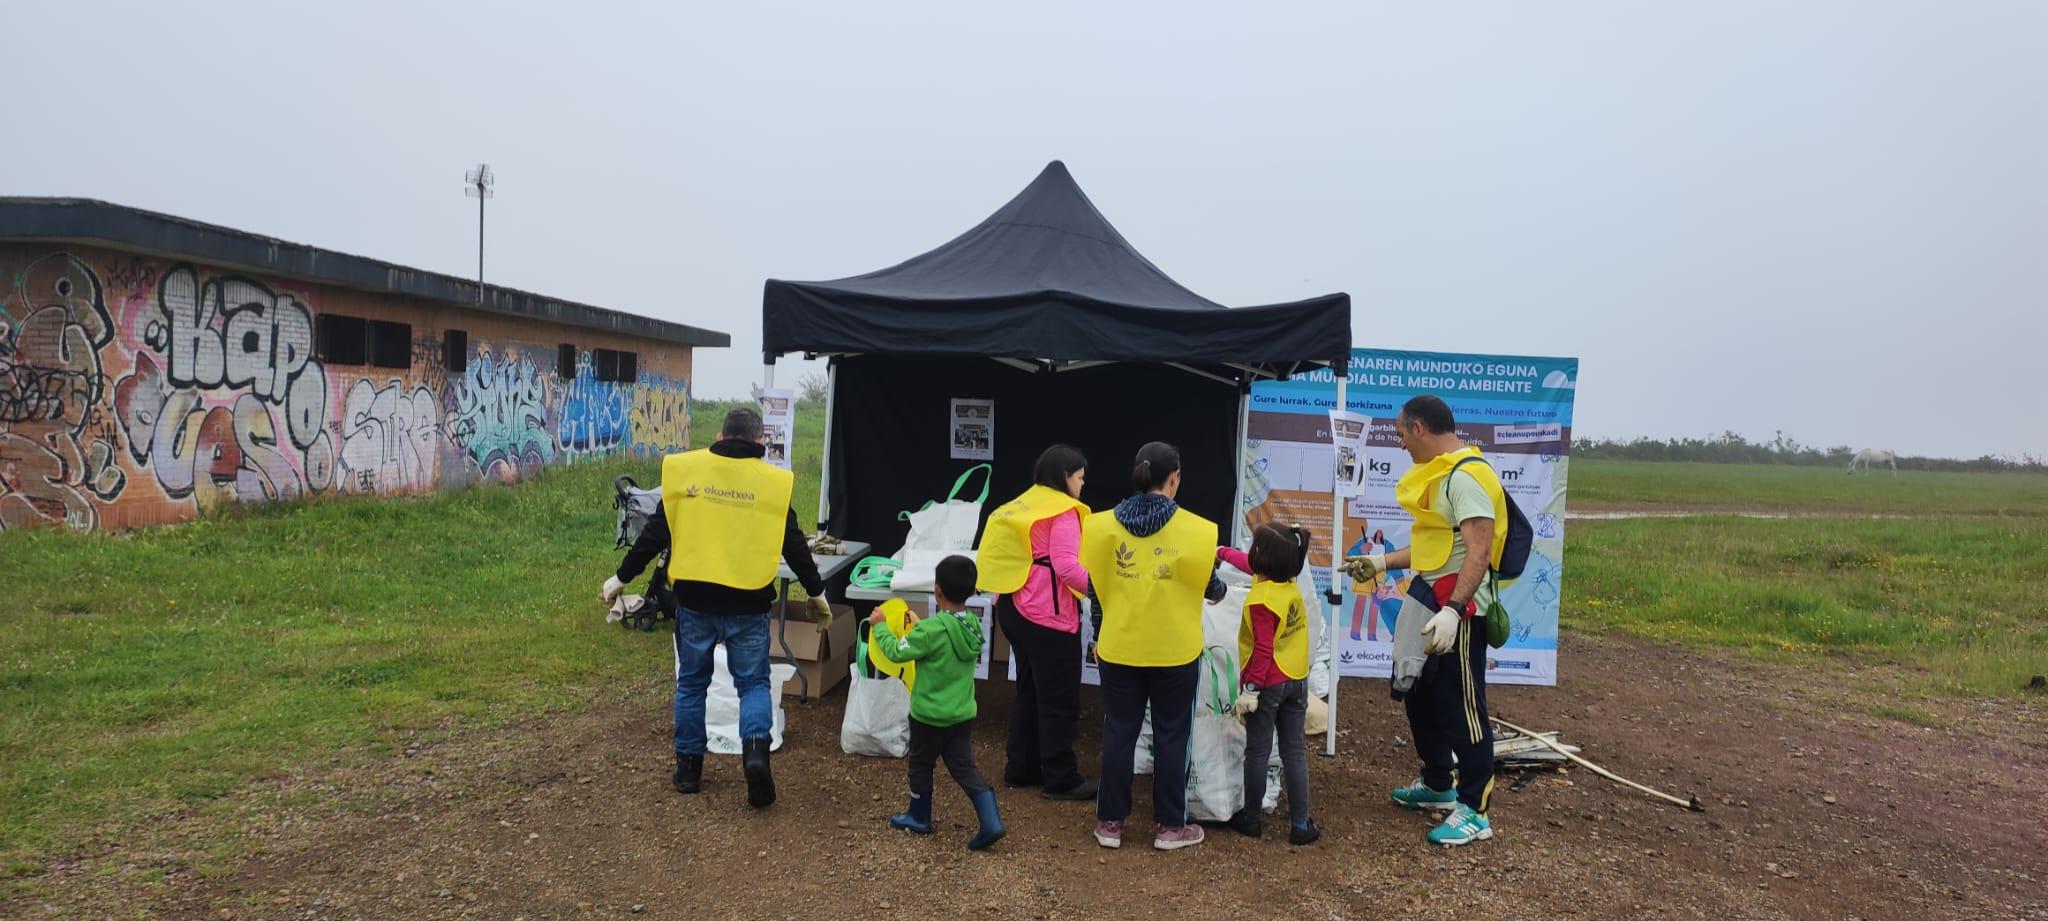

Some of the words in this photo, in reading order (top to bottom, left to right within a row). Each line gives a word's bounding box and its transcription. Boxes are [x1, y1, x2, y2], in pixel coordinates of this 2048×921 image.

[1407, 360, 1484, 375] MUNDUKO
[1487, 364, 1538, 378] EGUNA
[1379, 375, 1405, 387] DEL
[1407, 376, 1455, 389] MEDIO
[1458, 380, 1532, 393] AMBIENTE
[1253, 394, 1277, 404] Gure
[1279, 395, 1311, 407] lurrak.
[1346, 400, 1393, 411] torkizuna
[1485, 407, 1525, 417] Nuestro
[1527, 408, 1557, 418] futuro
[1316, 430, 1328, 438] En
[1369, 458, 1391, 475] kg
[704, 485, 755, 501] ekoetxea
